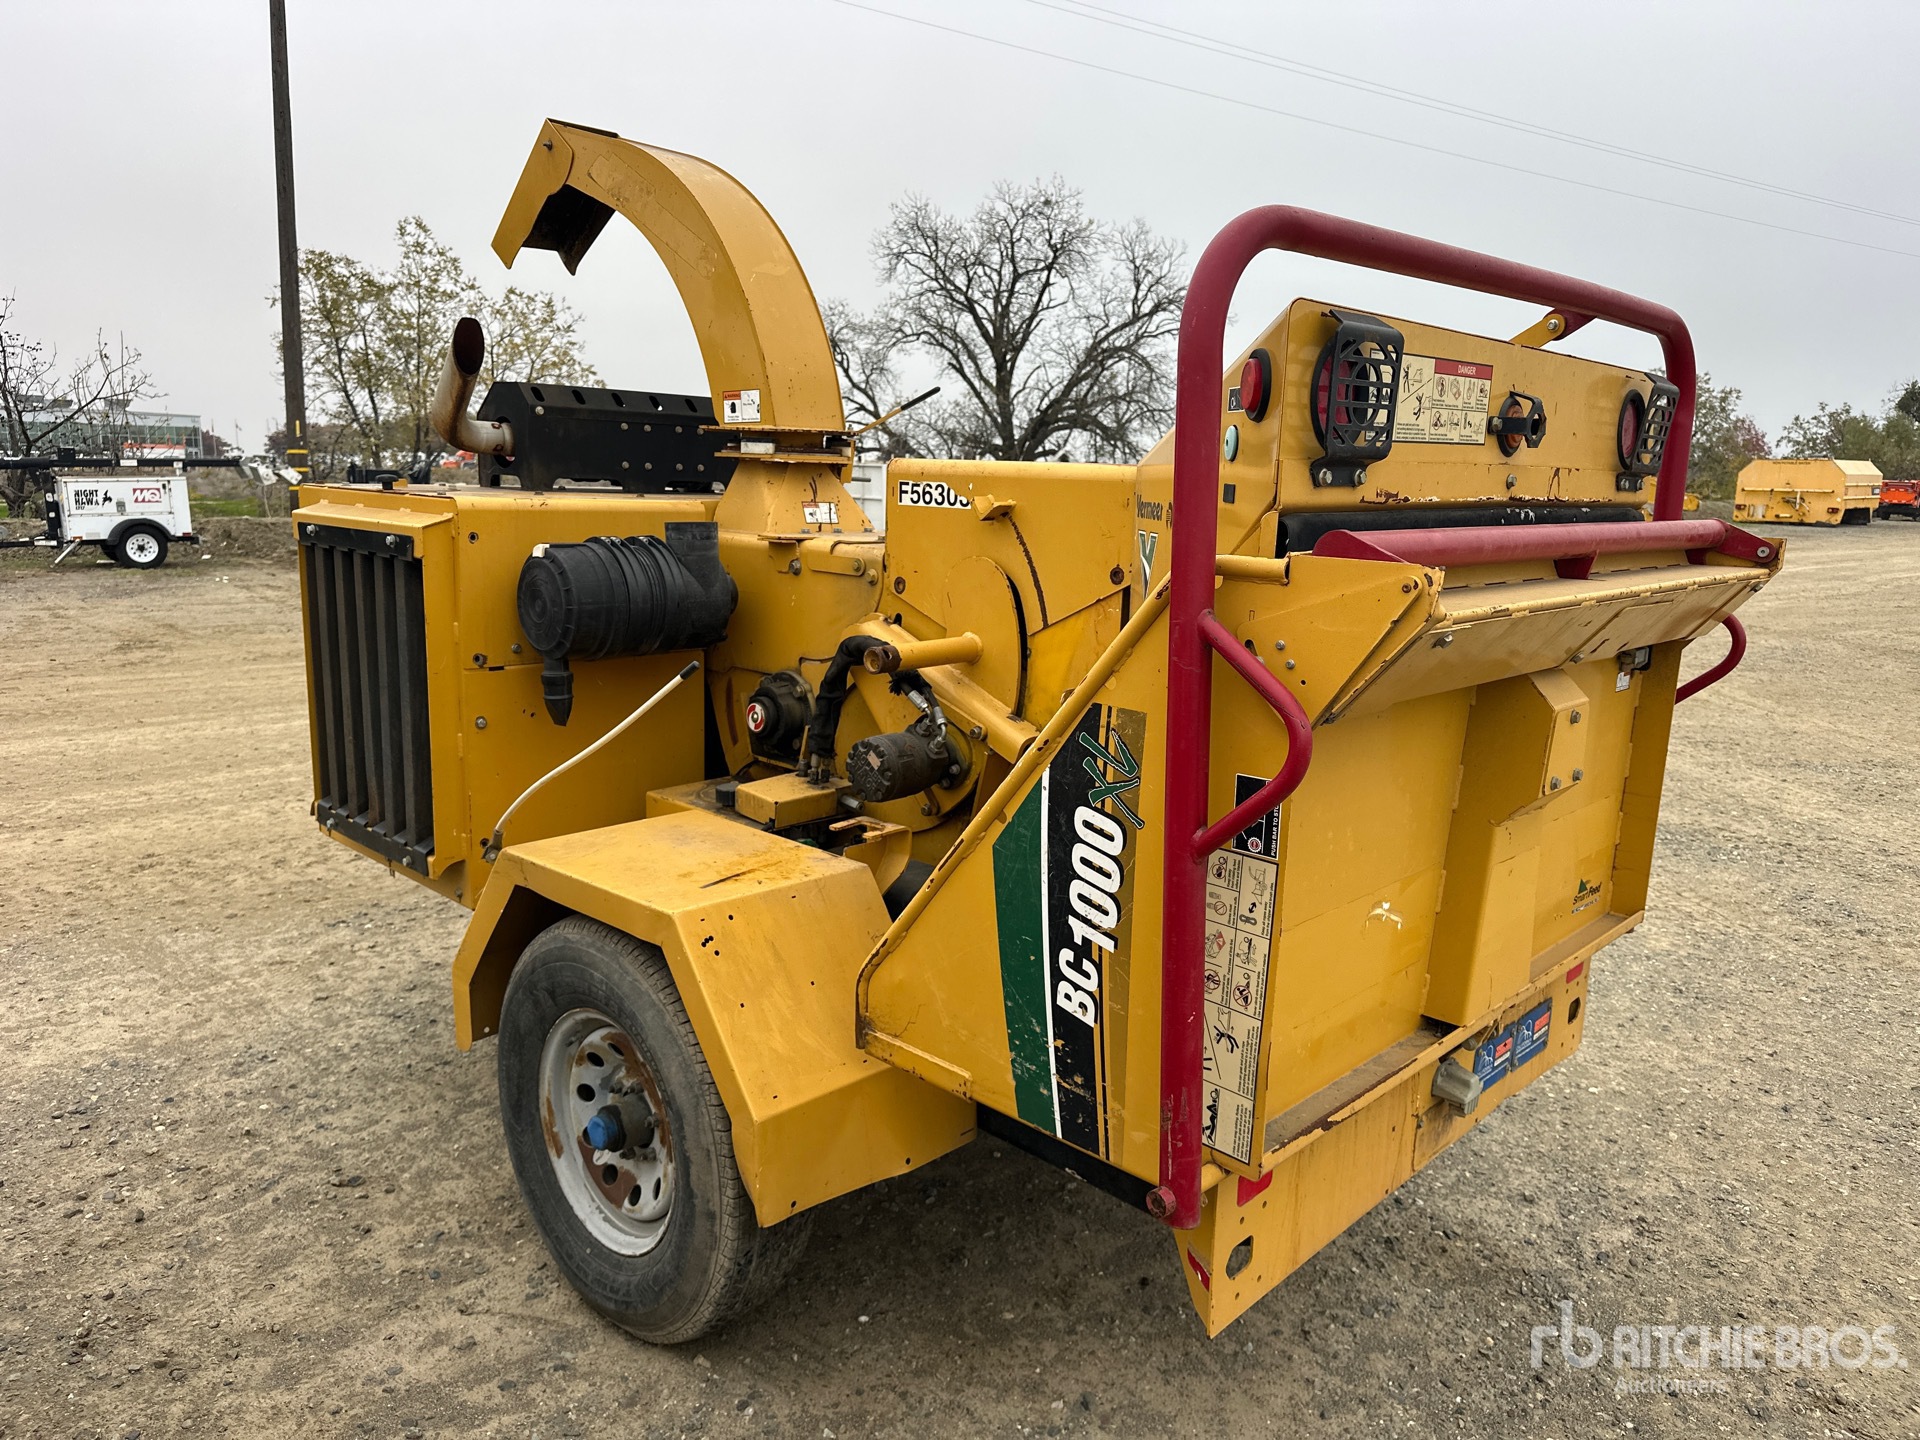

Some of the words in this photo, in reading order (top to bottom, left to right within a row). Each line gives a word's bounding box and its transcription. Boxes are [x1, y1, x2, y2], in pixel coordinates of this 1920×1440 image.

[1458, 365, 1476, 375] DANGER
[74, 490, 98, 498] NIGHT
[132, 488, 162, 502] MQ
[1136, 494, 1162, 521] Vermeer
[1273, 817, 1279, 826] TO
[1068, 805, 1124, 954] 1000
[1056, 946, 1099, 1028] BC
